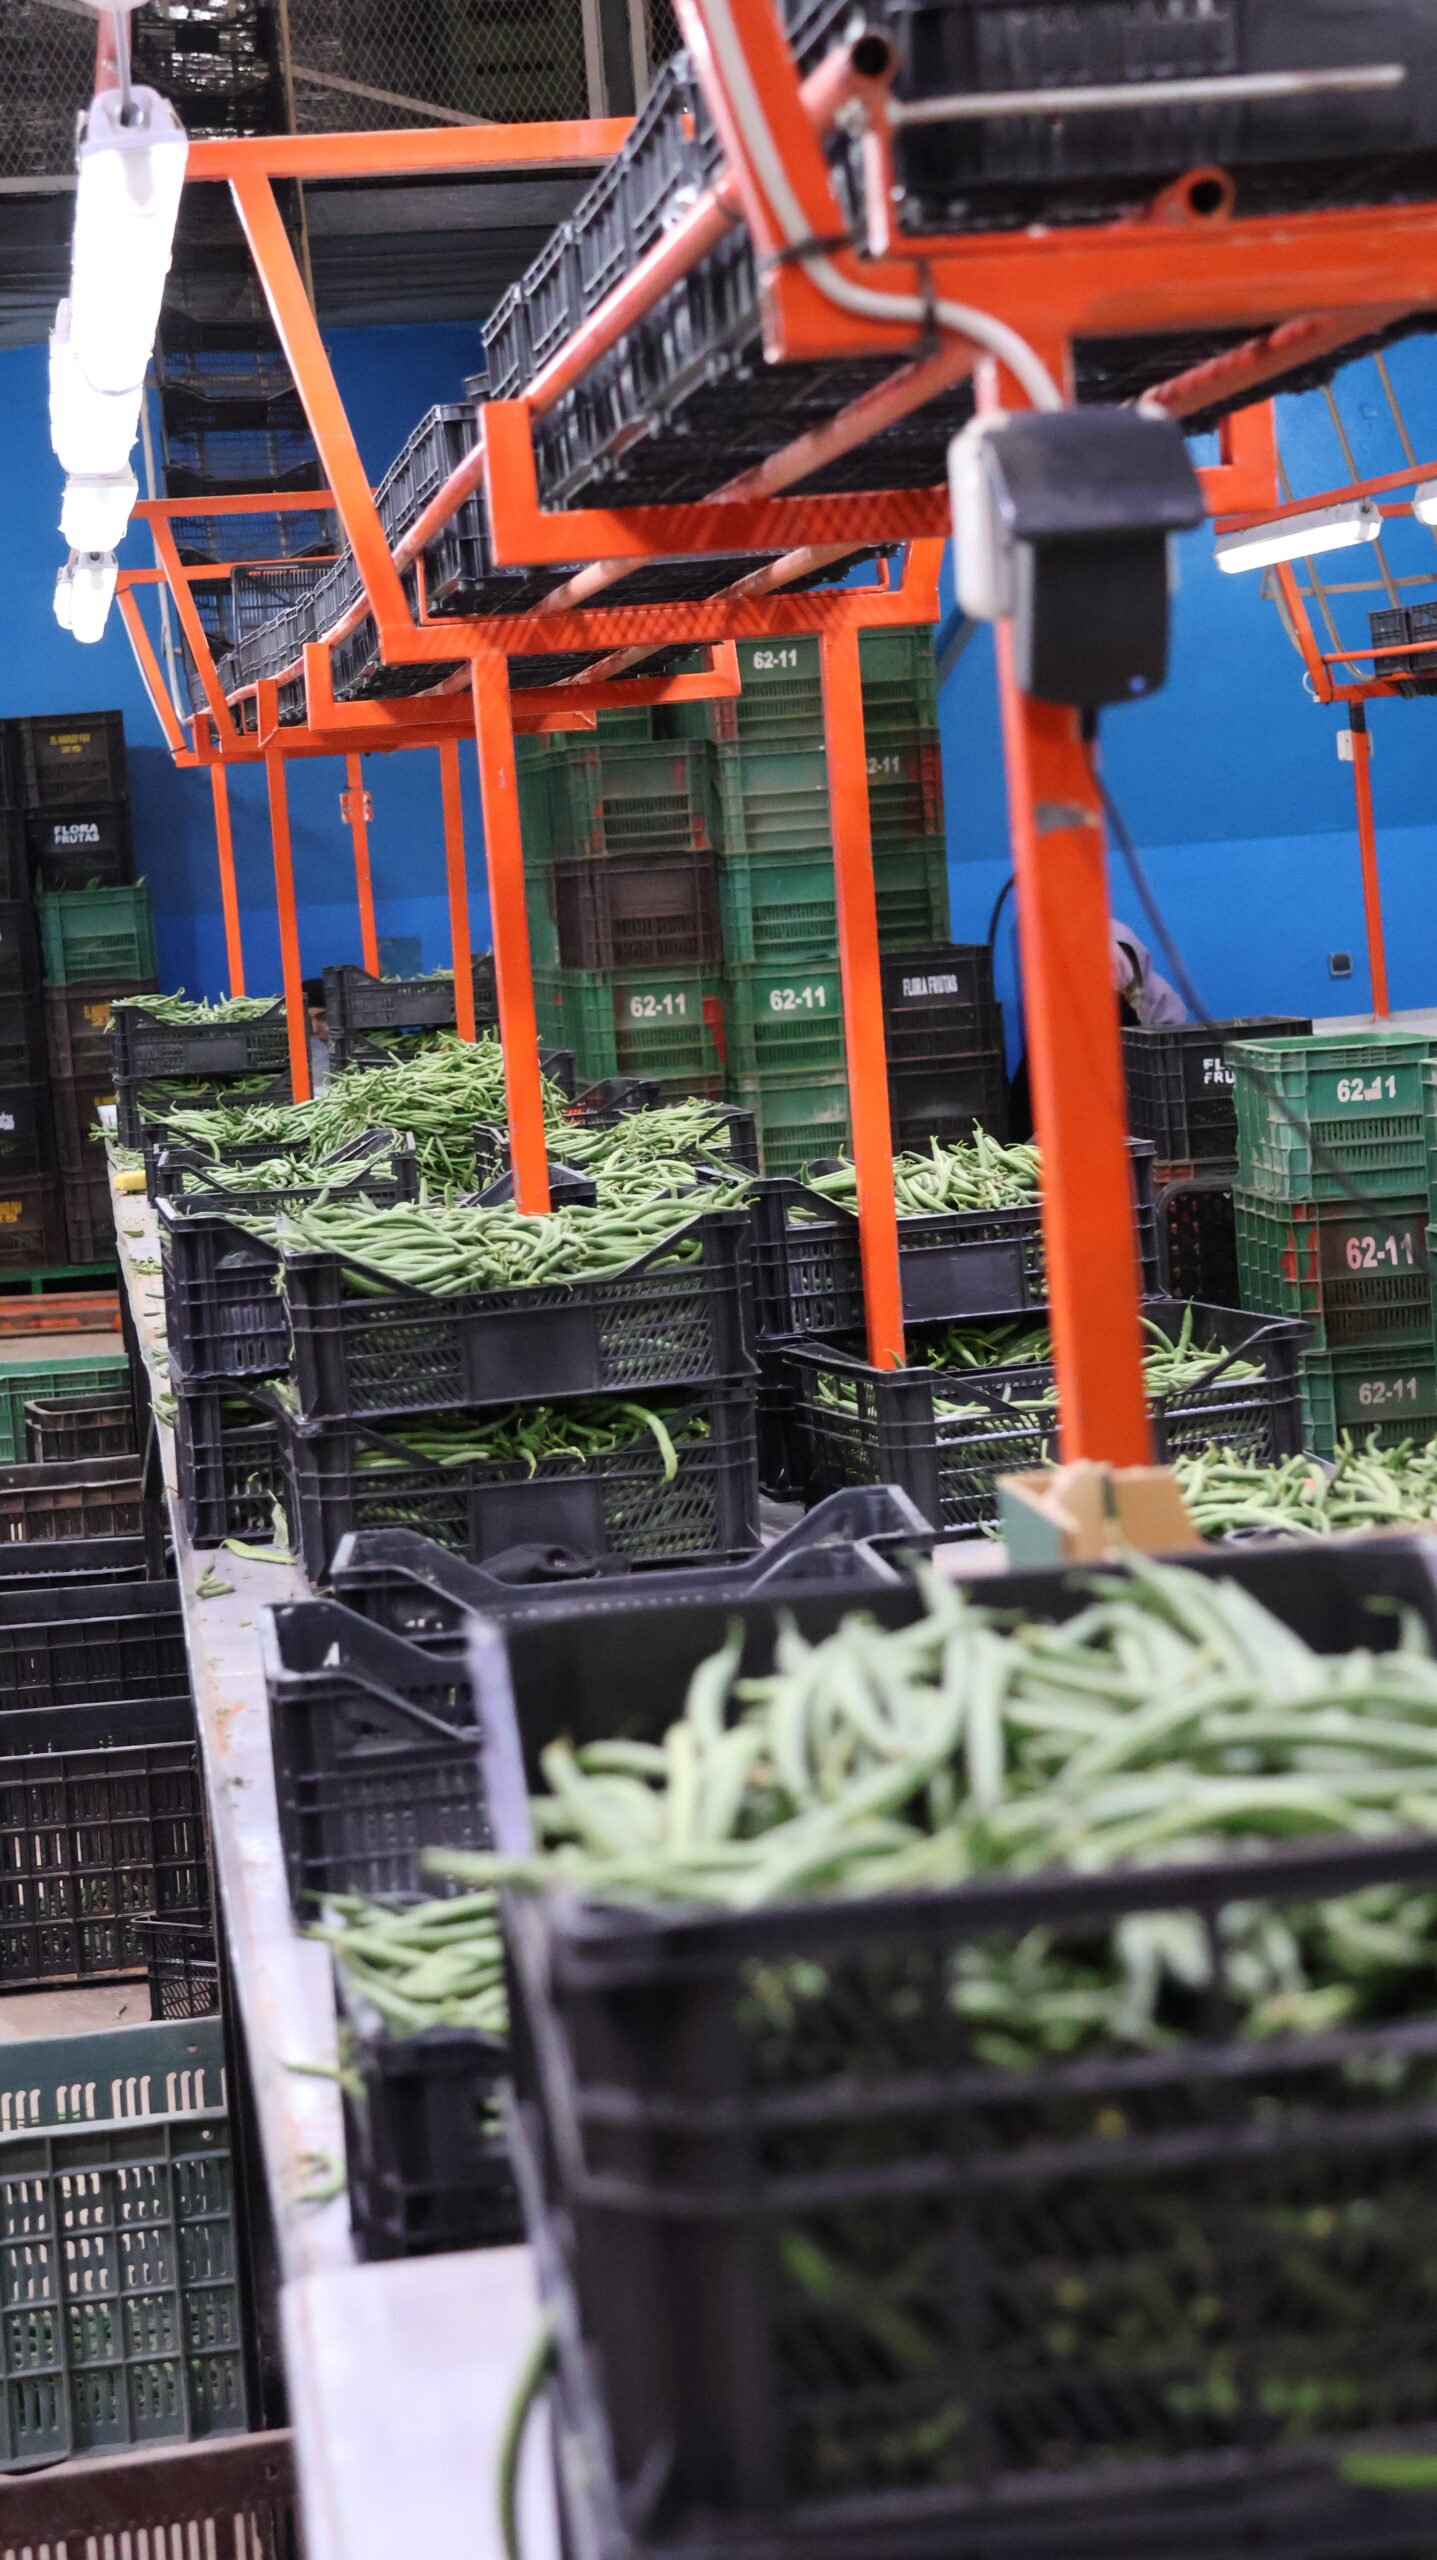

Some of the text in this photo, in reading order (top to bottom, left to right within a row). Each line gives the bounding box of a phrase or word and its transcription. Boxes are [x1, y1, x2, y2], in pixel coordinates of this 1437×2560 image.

[753, 649, 797, 669] 62-11
[866, 756, 900, 774] 2-11
[54, 823, 98, 835] FLORA
[54, 832, 100, 844] FRUTAS
[630, 993, 686, 1018] 62-11
[769, 986, 826, 1011] 62-11
[1203, 1058, 1230, 1070] FL
[1203, 1070, 1235, 1085] FRU
[1336, 1075, 1396, 1103] 62-11
[1346, 1232, 1414, 1270] 62-11
[1358, 1377, 1417, 1405] 62-11
